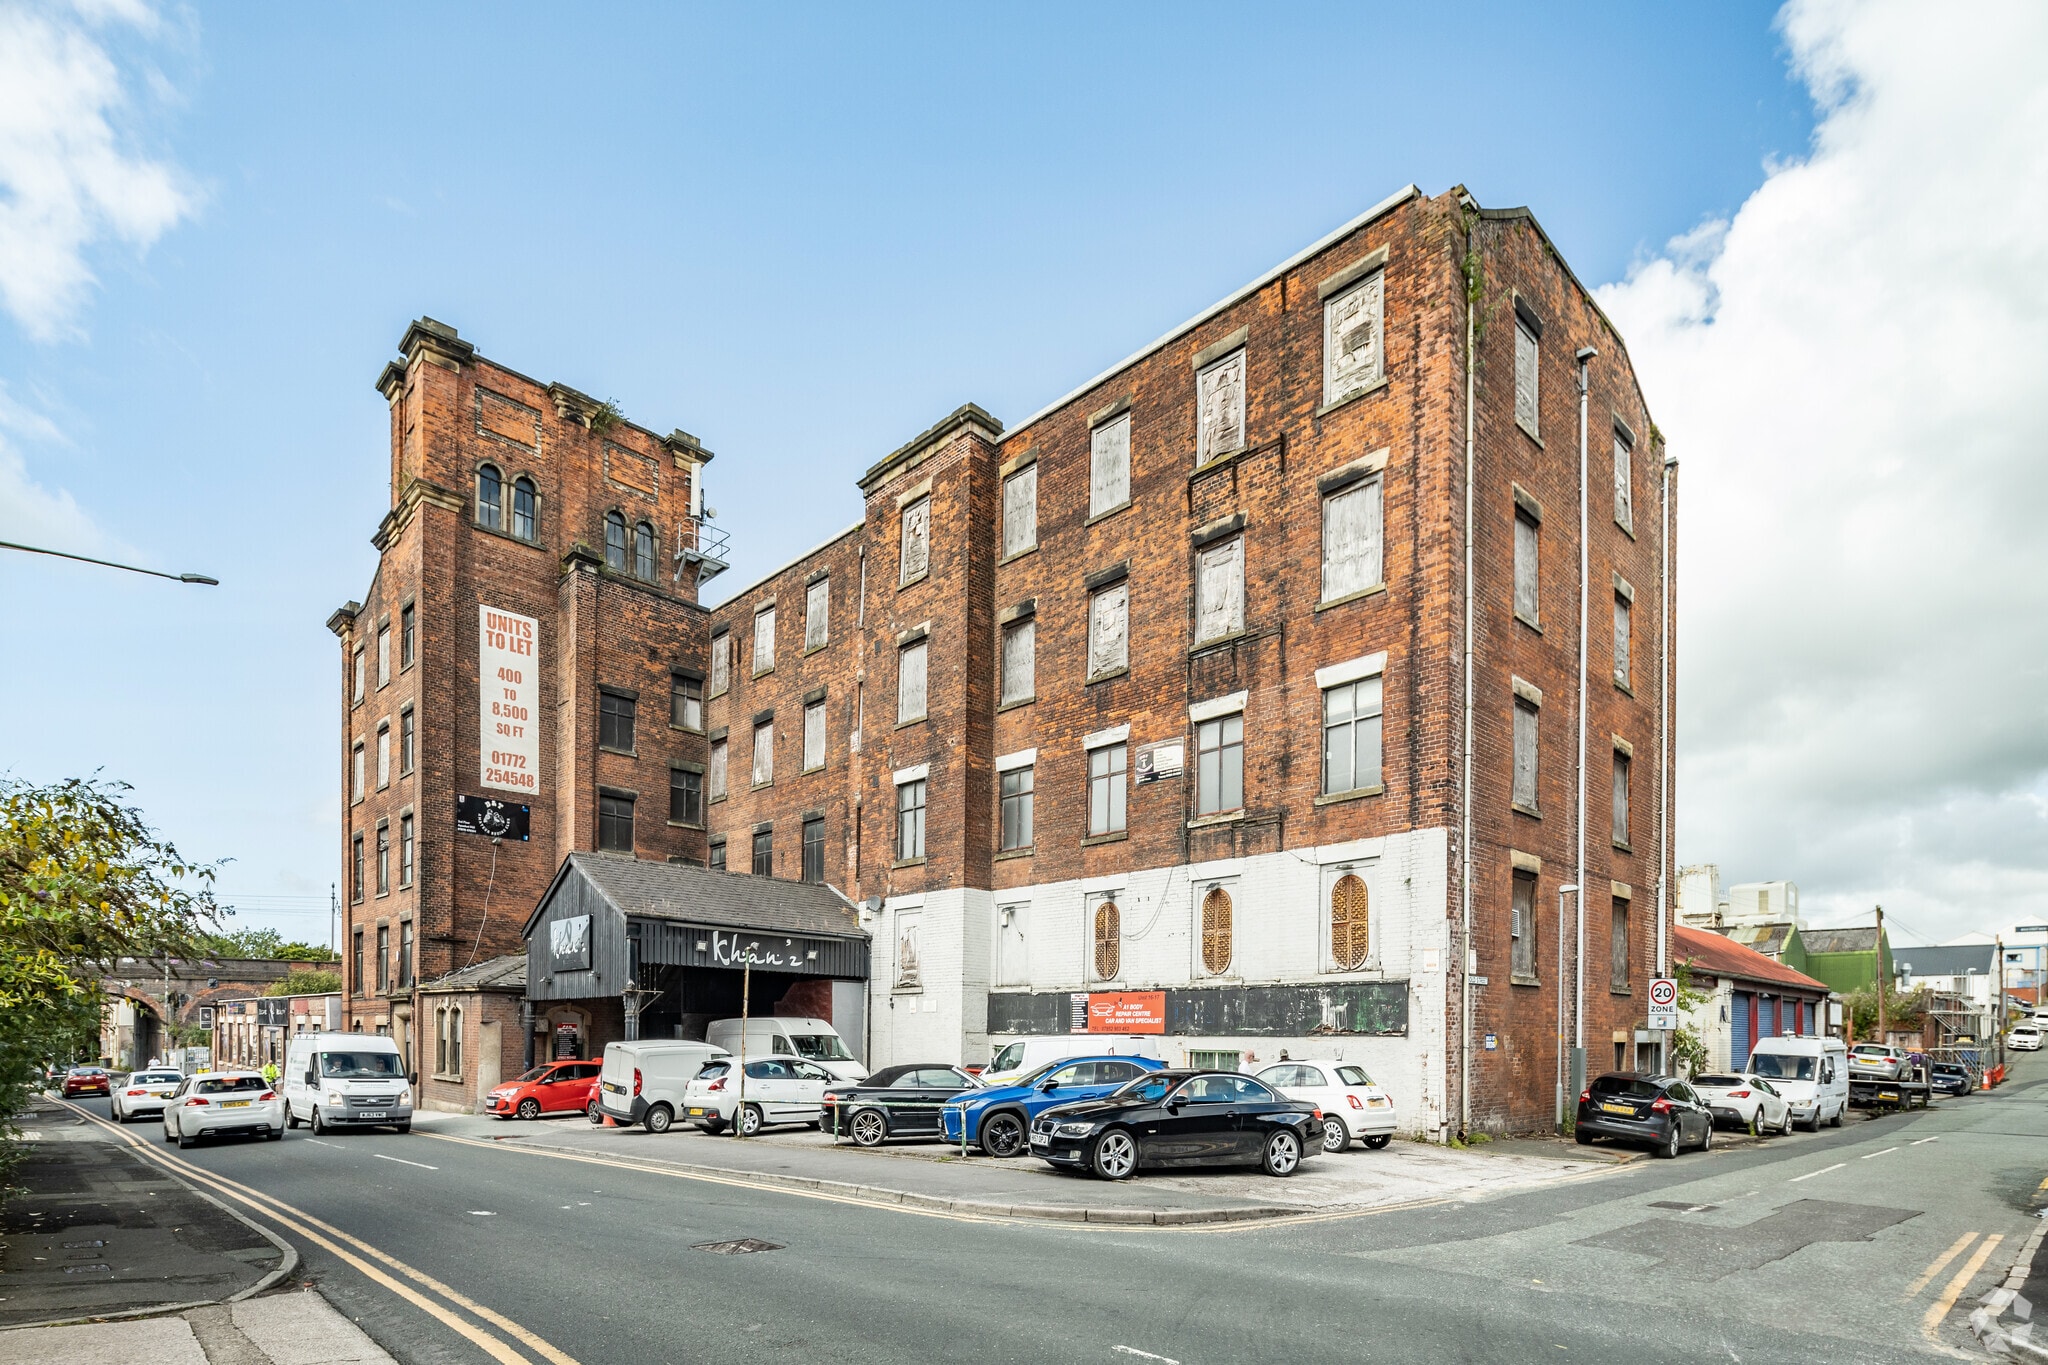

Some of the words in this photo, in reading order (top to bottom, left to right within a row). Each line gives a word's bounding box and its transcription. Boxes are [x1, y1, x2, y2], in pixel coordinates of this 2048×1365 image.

[487, 612, 532, 638] UNITS
[486, 630, 505, 650] TO
[510, 636, 532, 656] LET
[498, 667, 522, 684] 400
[503, 688, 516, 701] TO
[492, 702, 528, 720] 8,500
[496, 722, 510, 737] SQ
[513, 726, 524, 738] FT
[492, 750, 526, 768] 01772
[486, 768, 534, 788] 254548
[712, 931, 802, 967] Khan'z
[1655, 988, 1672, 998] 20
